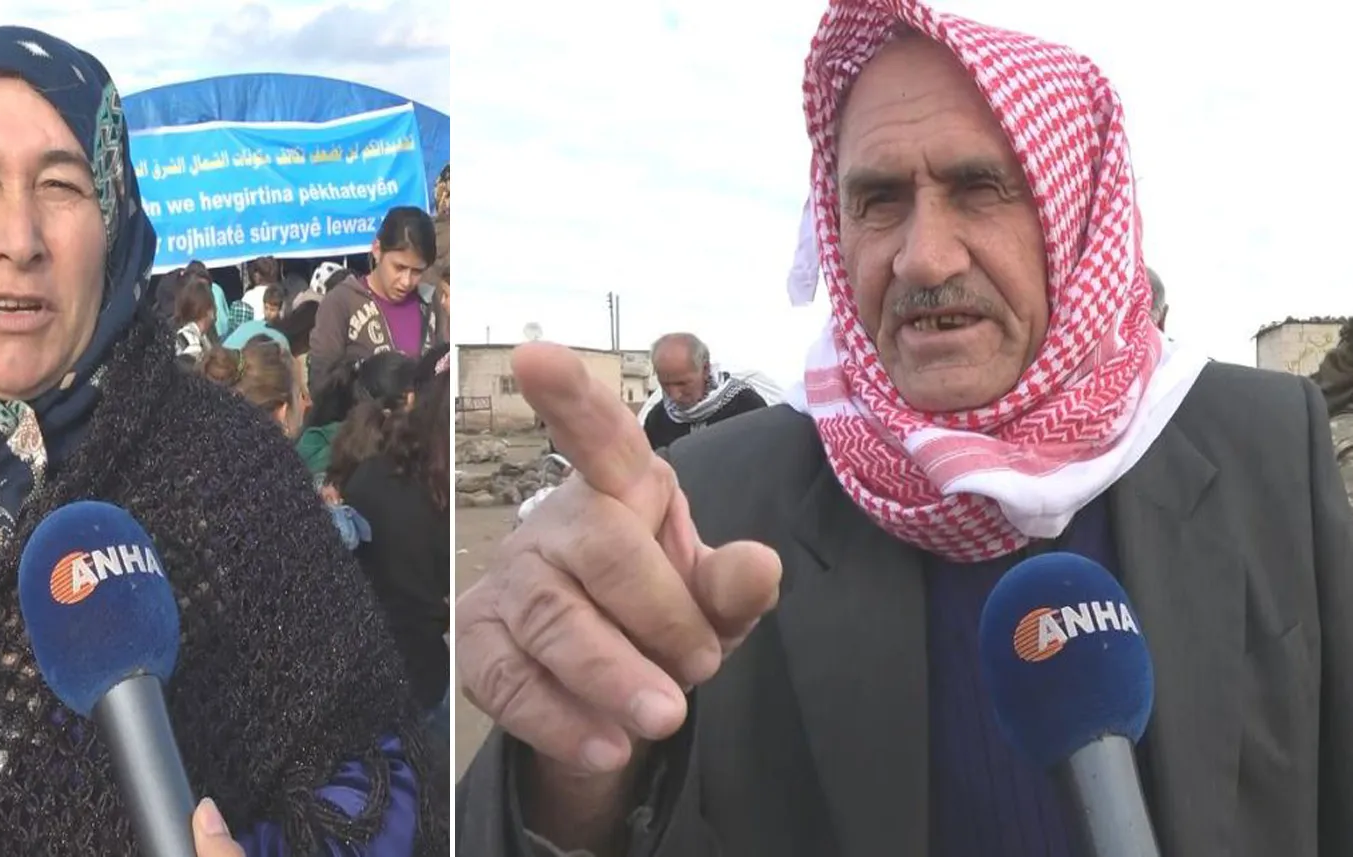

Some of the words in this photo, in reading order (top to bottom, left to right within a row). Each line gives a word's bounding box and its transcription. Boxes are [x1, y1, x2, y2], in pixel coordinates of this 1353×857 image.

[166, 198, 195, 215] we
[199, 185, 294, 212] hevgirtina
[326, 215, 376, 236] lewaz
[71, 544, 164, 595] ANHA
[1038, 601, 1140, 653] ANHA
